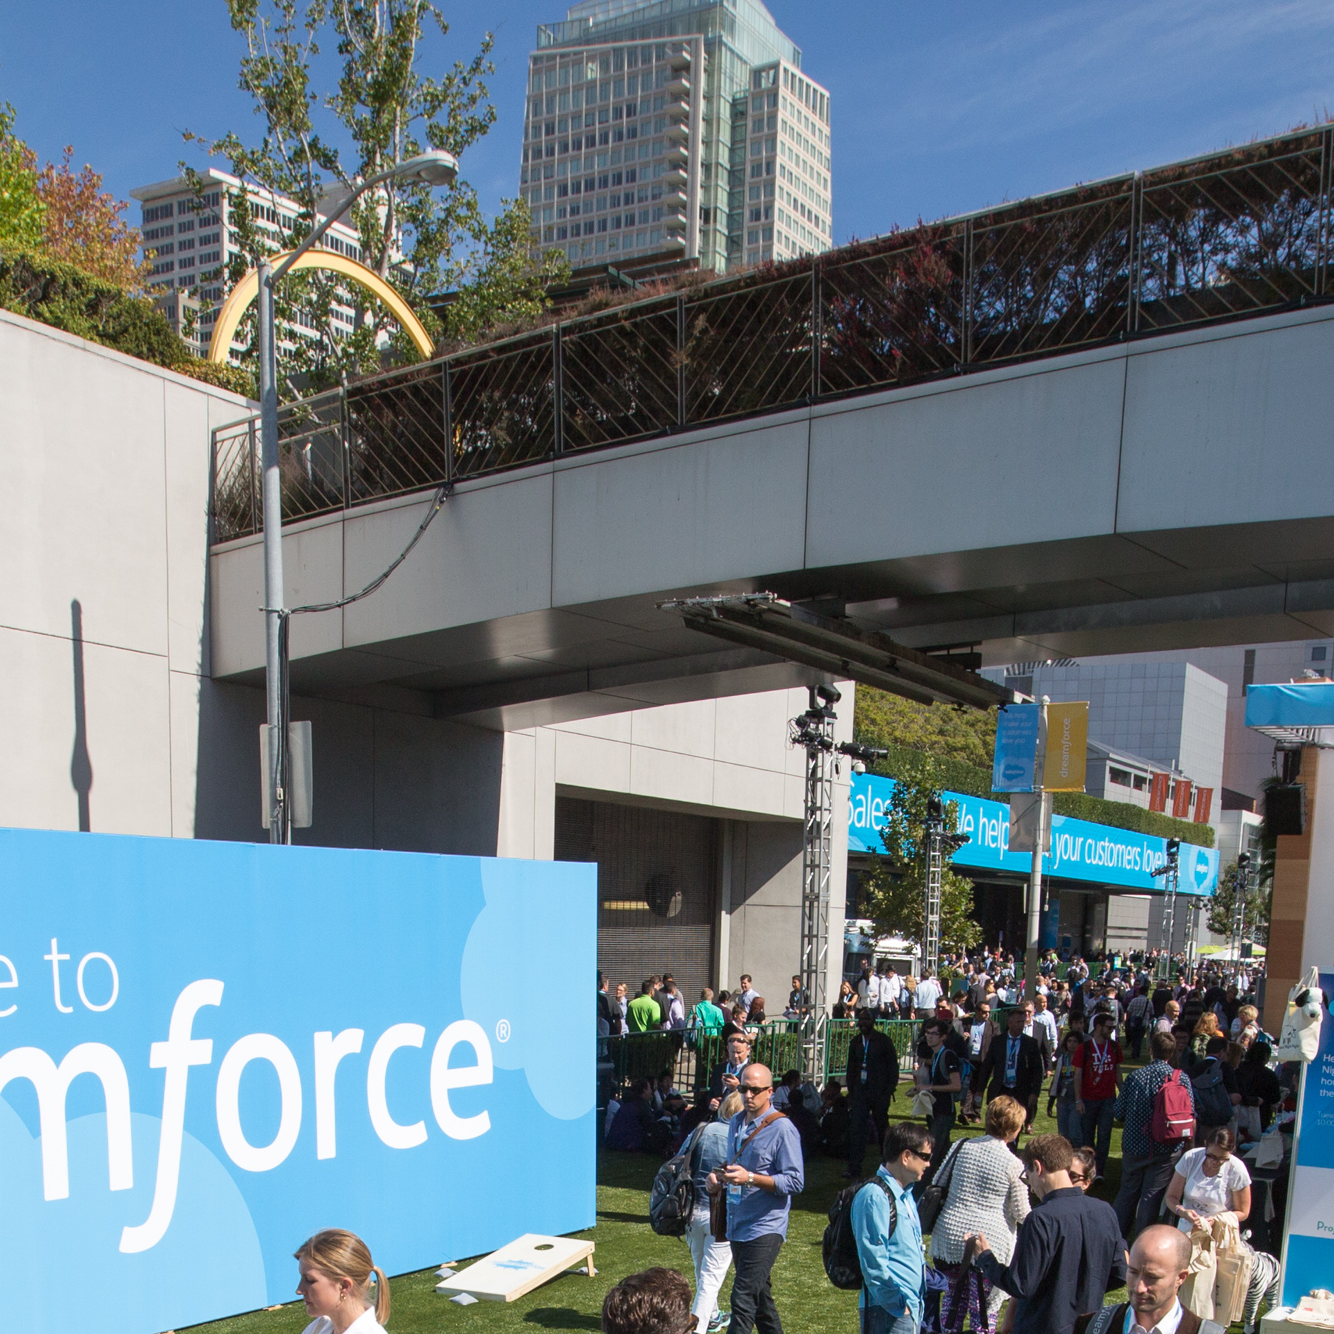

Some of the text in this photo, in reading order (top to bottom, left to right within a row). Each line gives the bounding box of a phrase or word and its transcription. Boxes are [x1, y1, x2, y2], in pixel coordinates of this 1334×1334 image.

[1059, 717, 1072, 778] dreamforce
[1055, 832, 1084, 870] your
[1085, 836, 1142, 872] customers
[44, 936, 119, 1013] to
